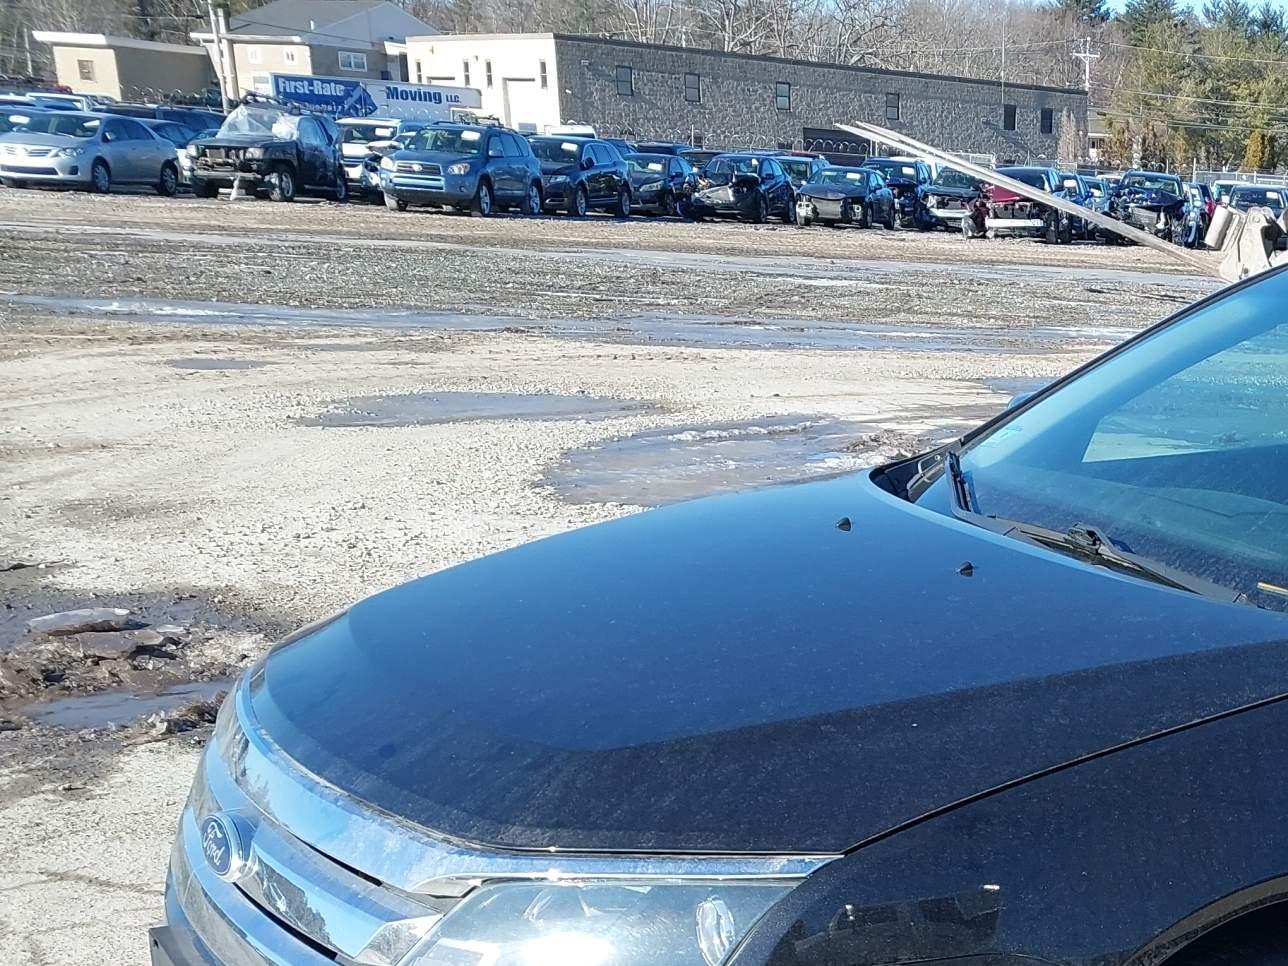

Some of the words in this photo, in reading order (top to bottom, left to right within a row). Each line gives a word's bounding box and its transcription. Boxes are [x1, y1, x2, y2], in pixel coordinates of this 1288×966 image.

[278, 78, 345, 96] First-Rate
[386, 86, 442, 104] Moving
[203, 821, 226, 865] Ford
